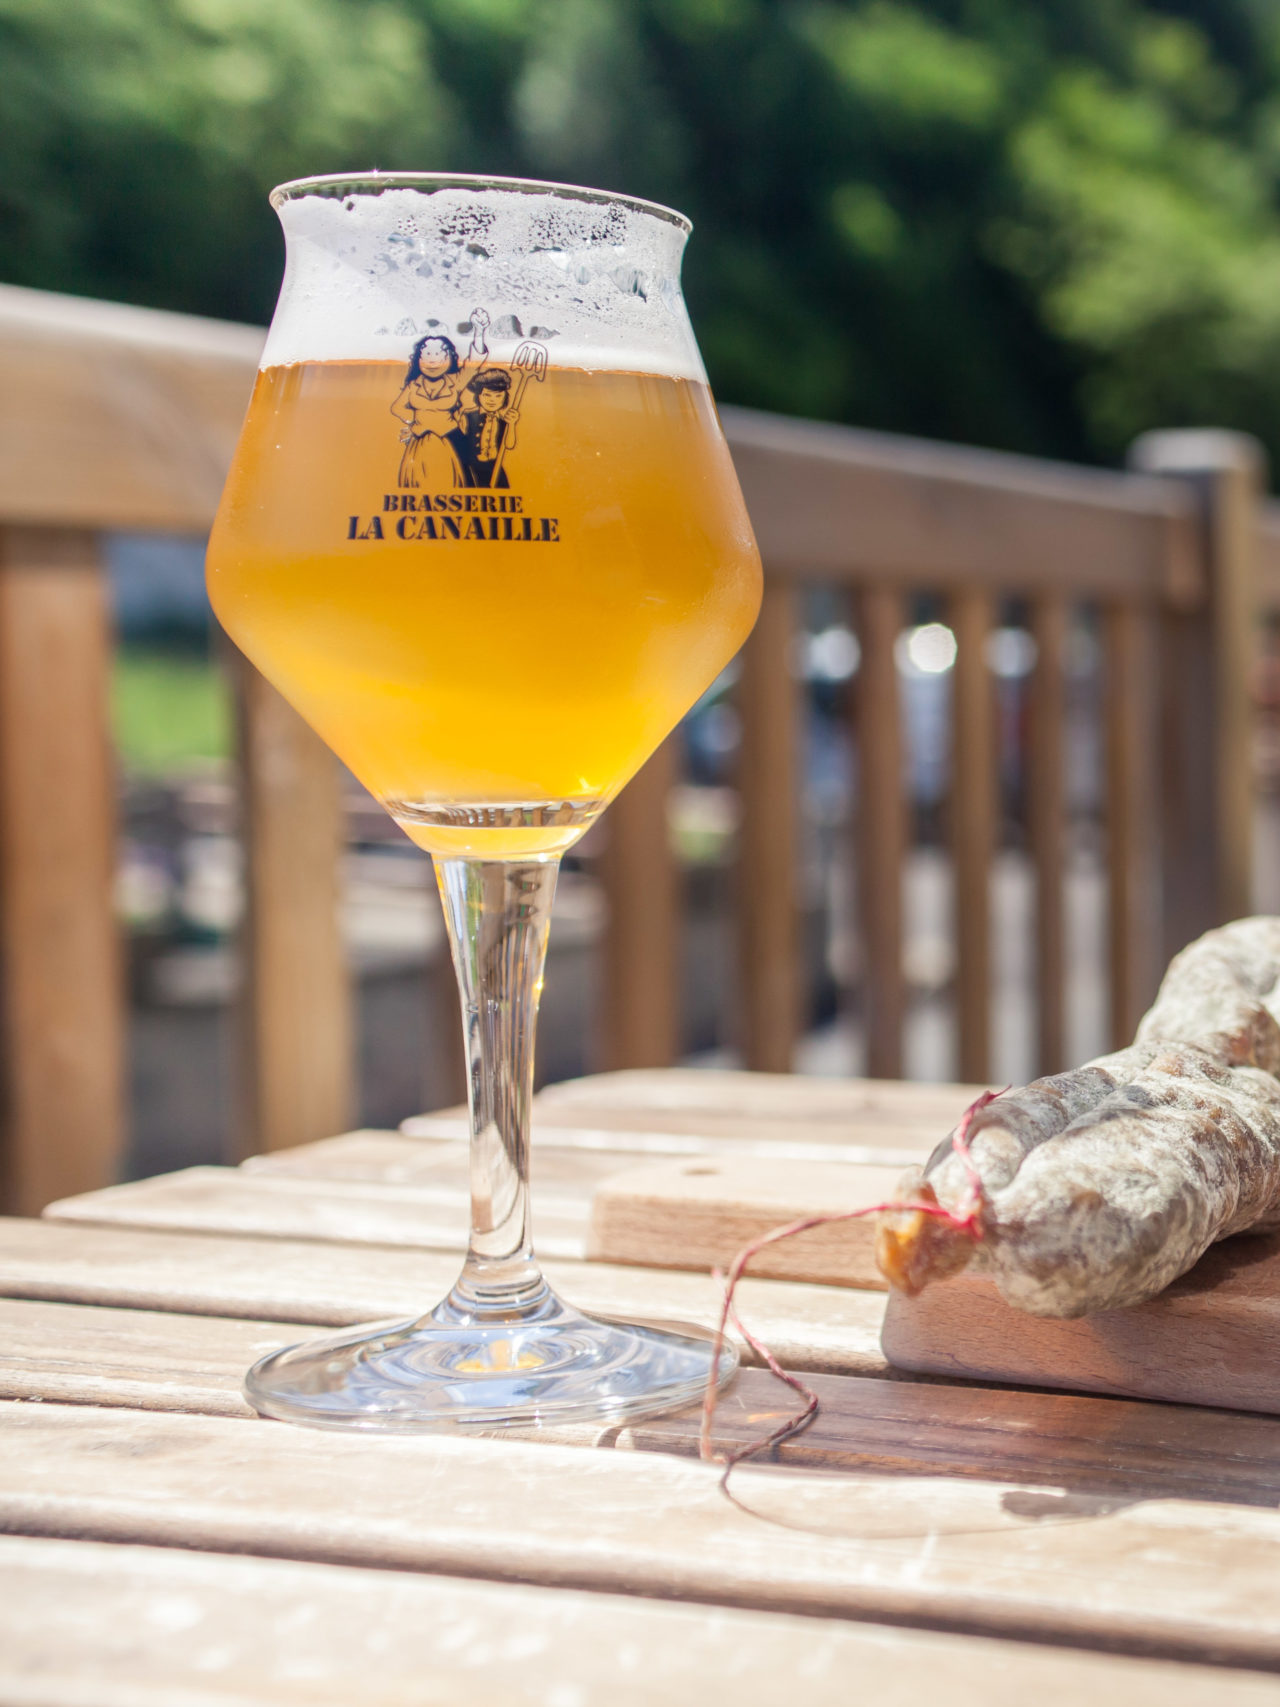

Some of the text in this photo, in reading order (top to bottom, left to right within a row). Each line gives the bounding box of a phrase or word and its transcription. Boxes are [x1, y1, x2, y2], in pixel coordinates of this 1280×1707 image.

[383, 494, 524, 513] BRASSERIE
[347, 516, 560, 542] LA CANAILLE
